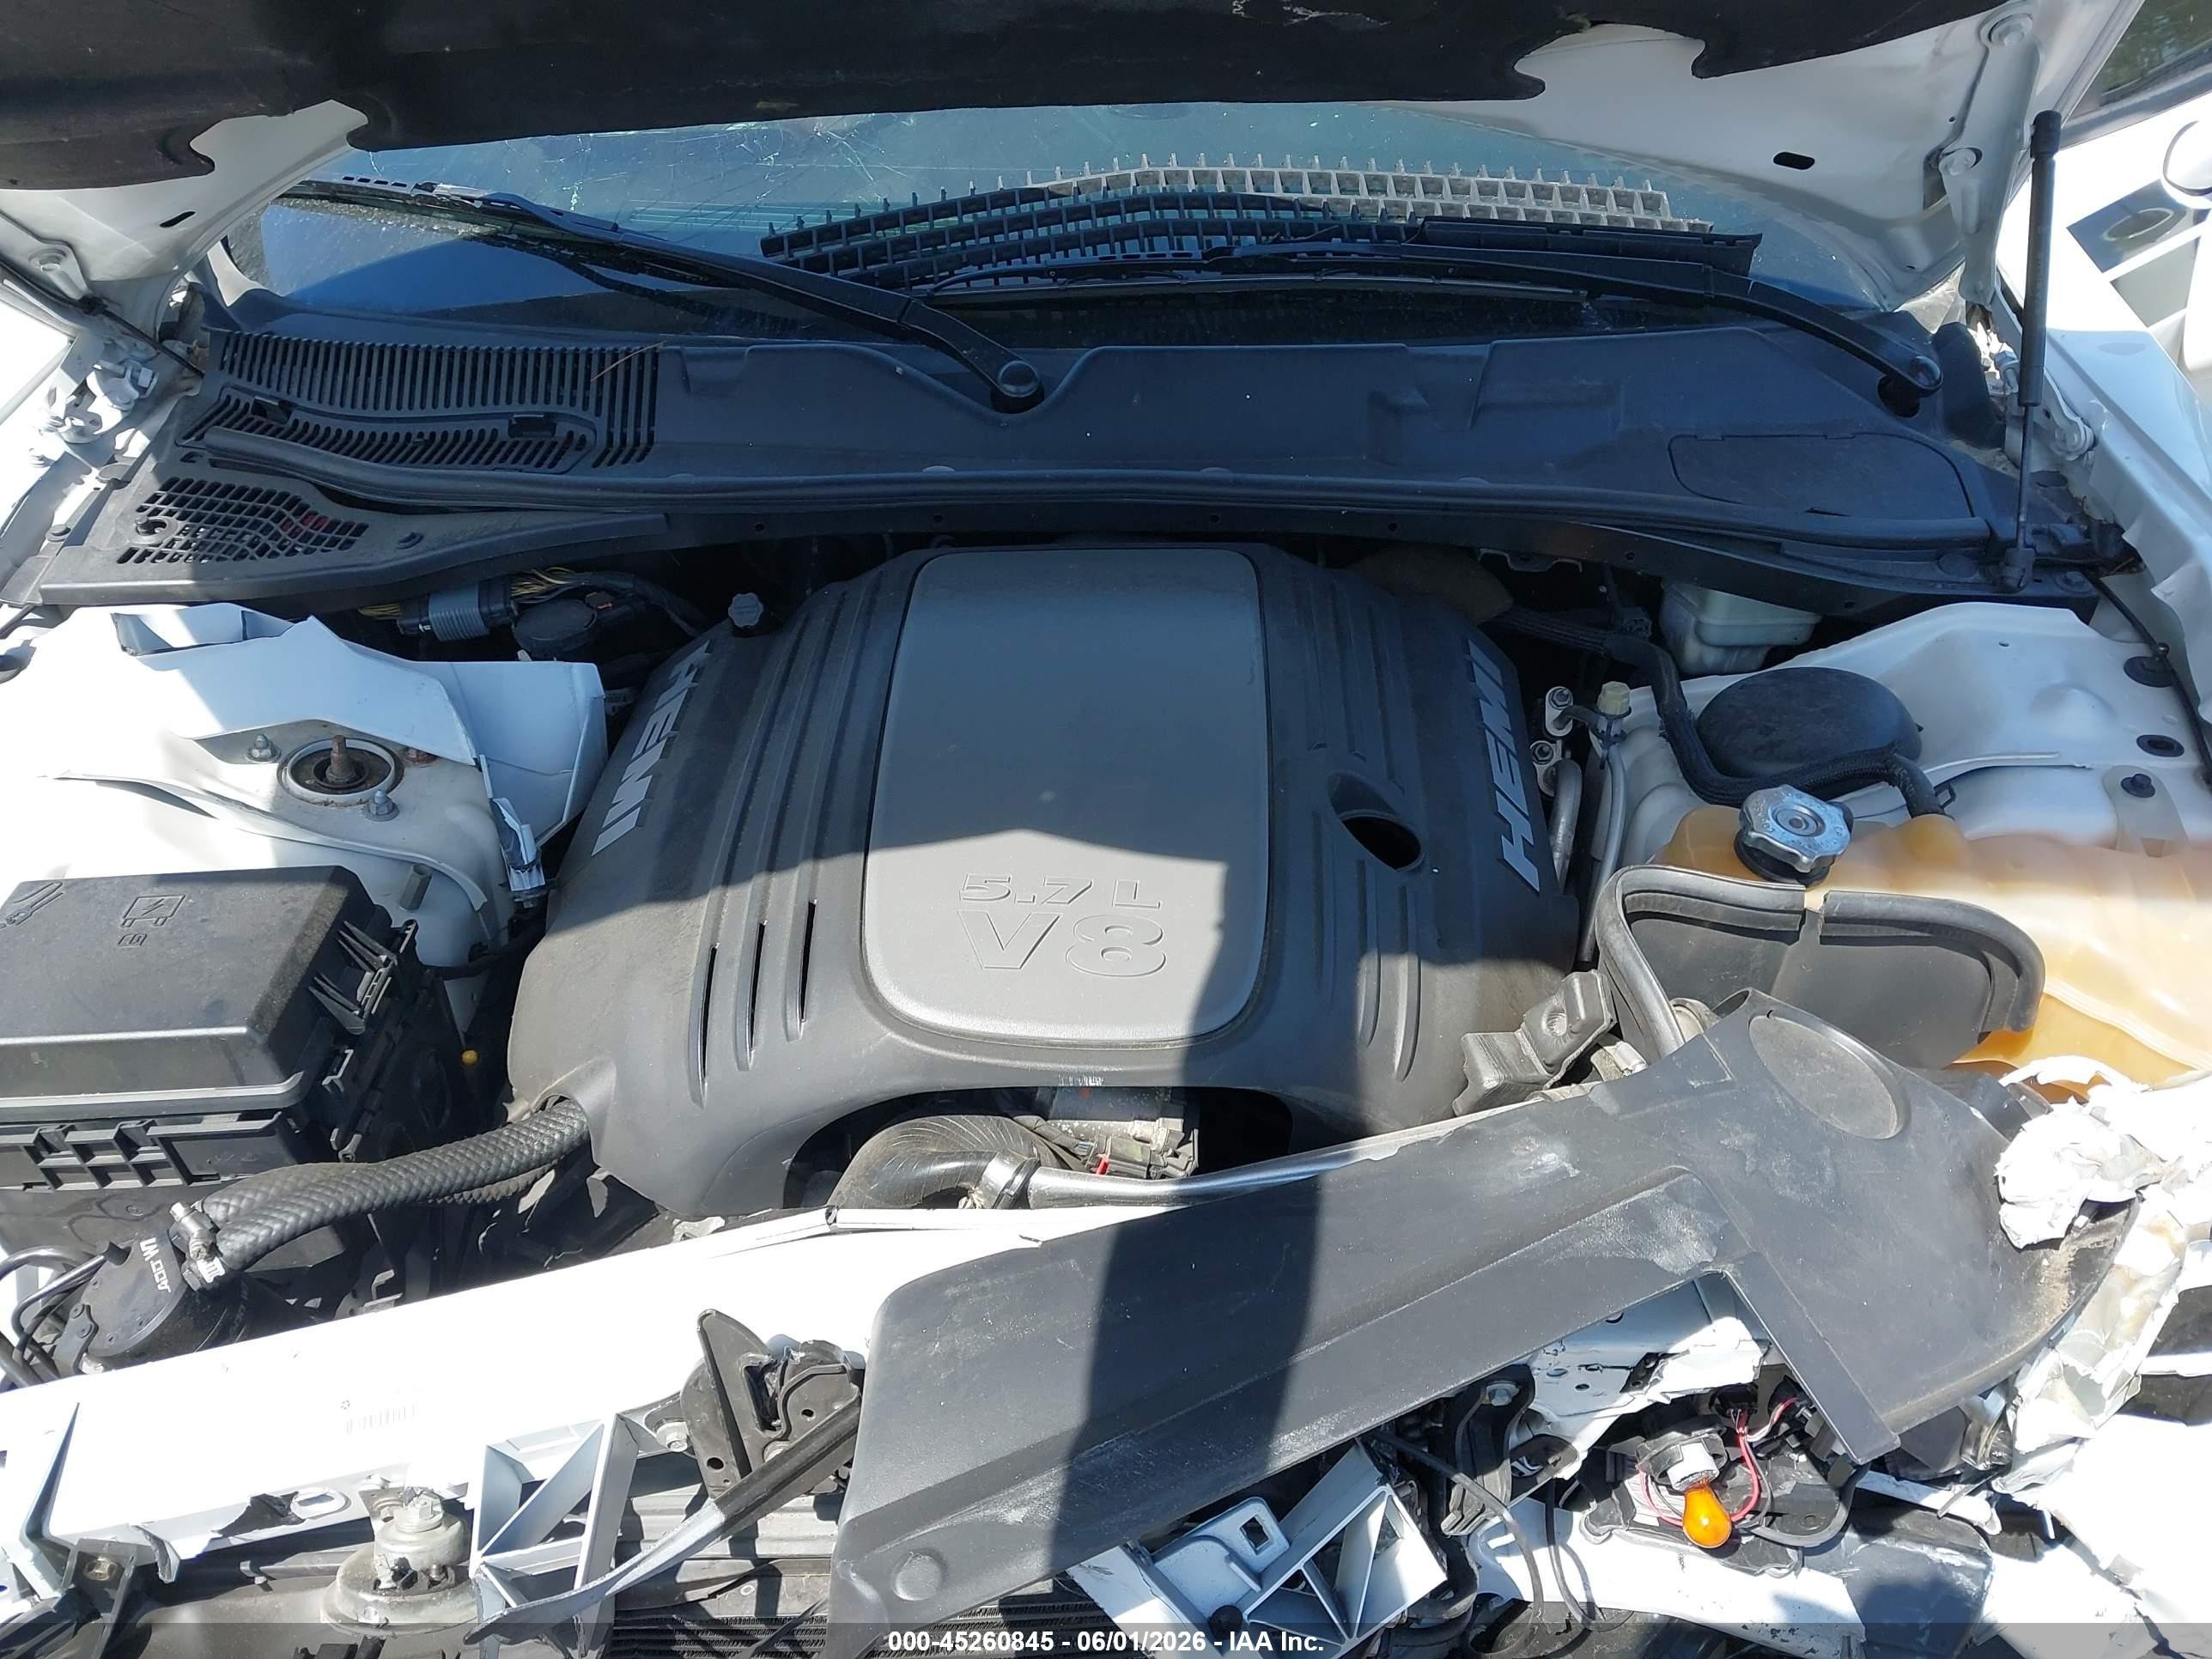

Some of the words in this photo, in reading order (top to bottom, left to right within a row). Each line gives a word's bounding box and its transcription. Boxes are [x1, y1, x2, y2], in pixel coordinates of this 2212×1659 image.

[591, 639, 711, 857] HEMI
[1468, 639, 1540, 892] HEMI
[957, 909, 1167, 977] V8
[959, 872, 1094, 906] 5.7
[1112, 878, 1163, 909] L
